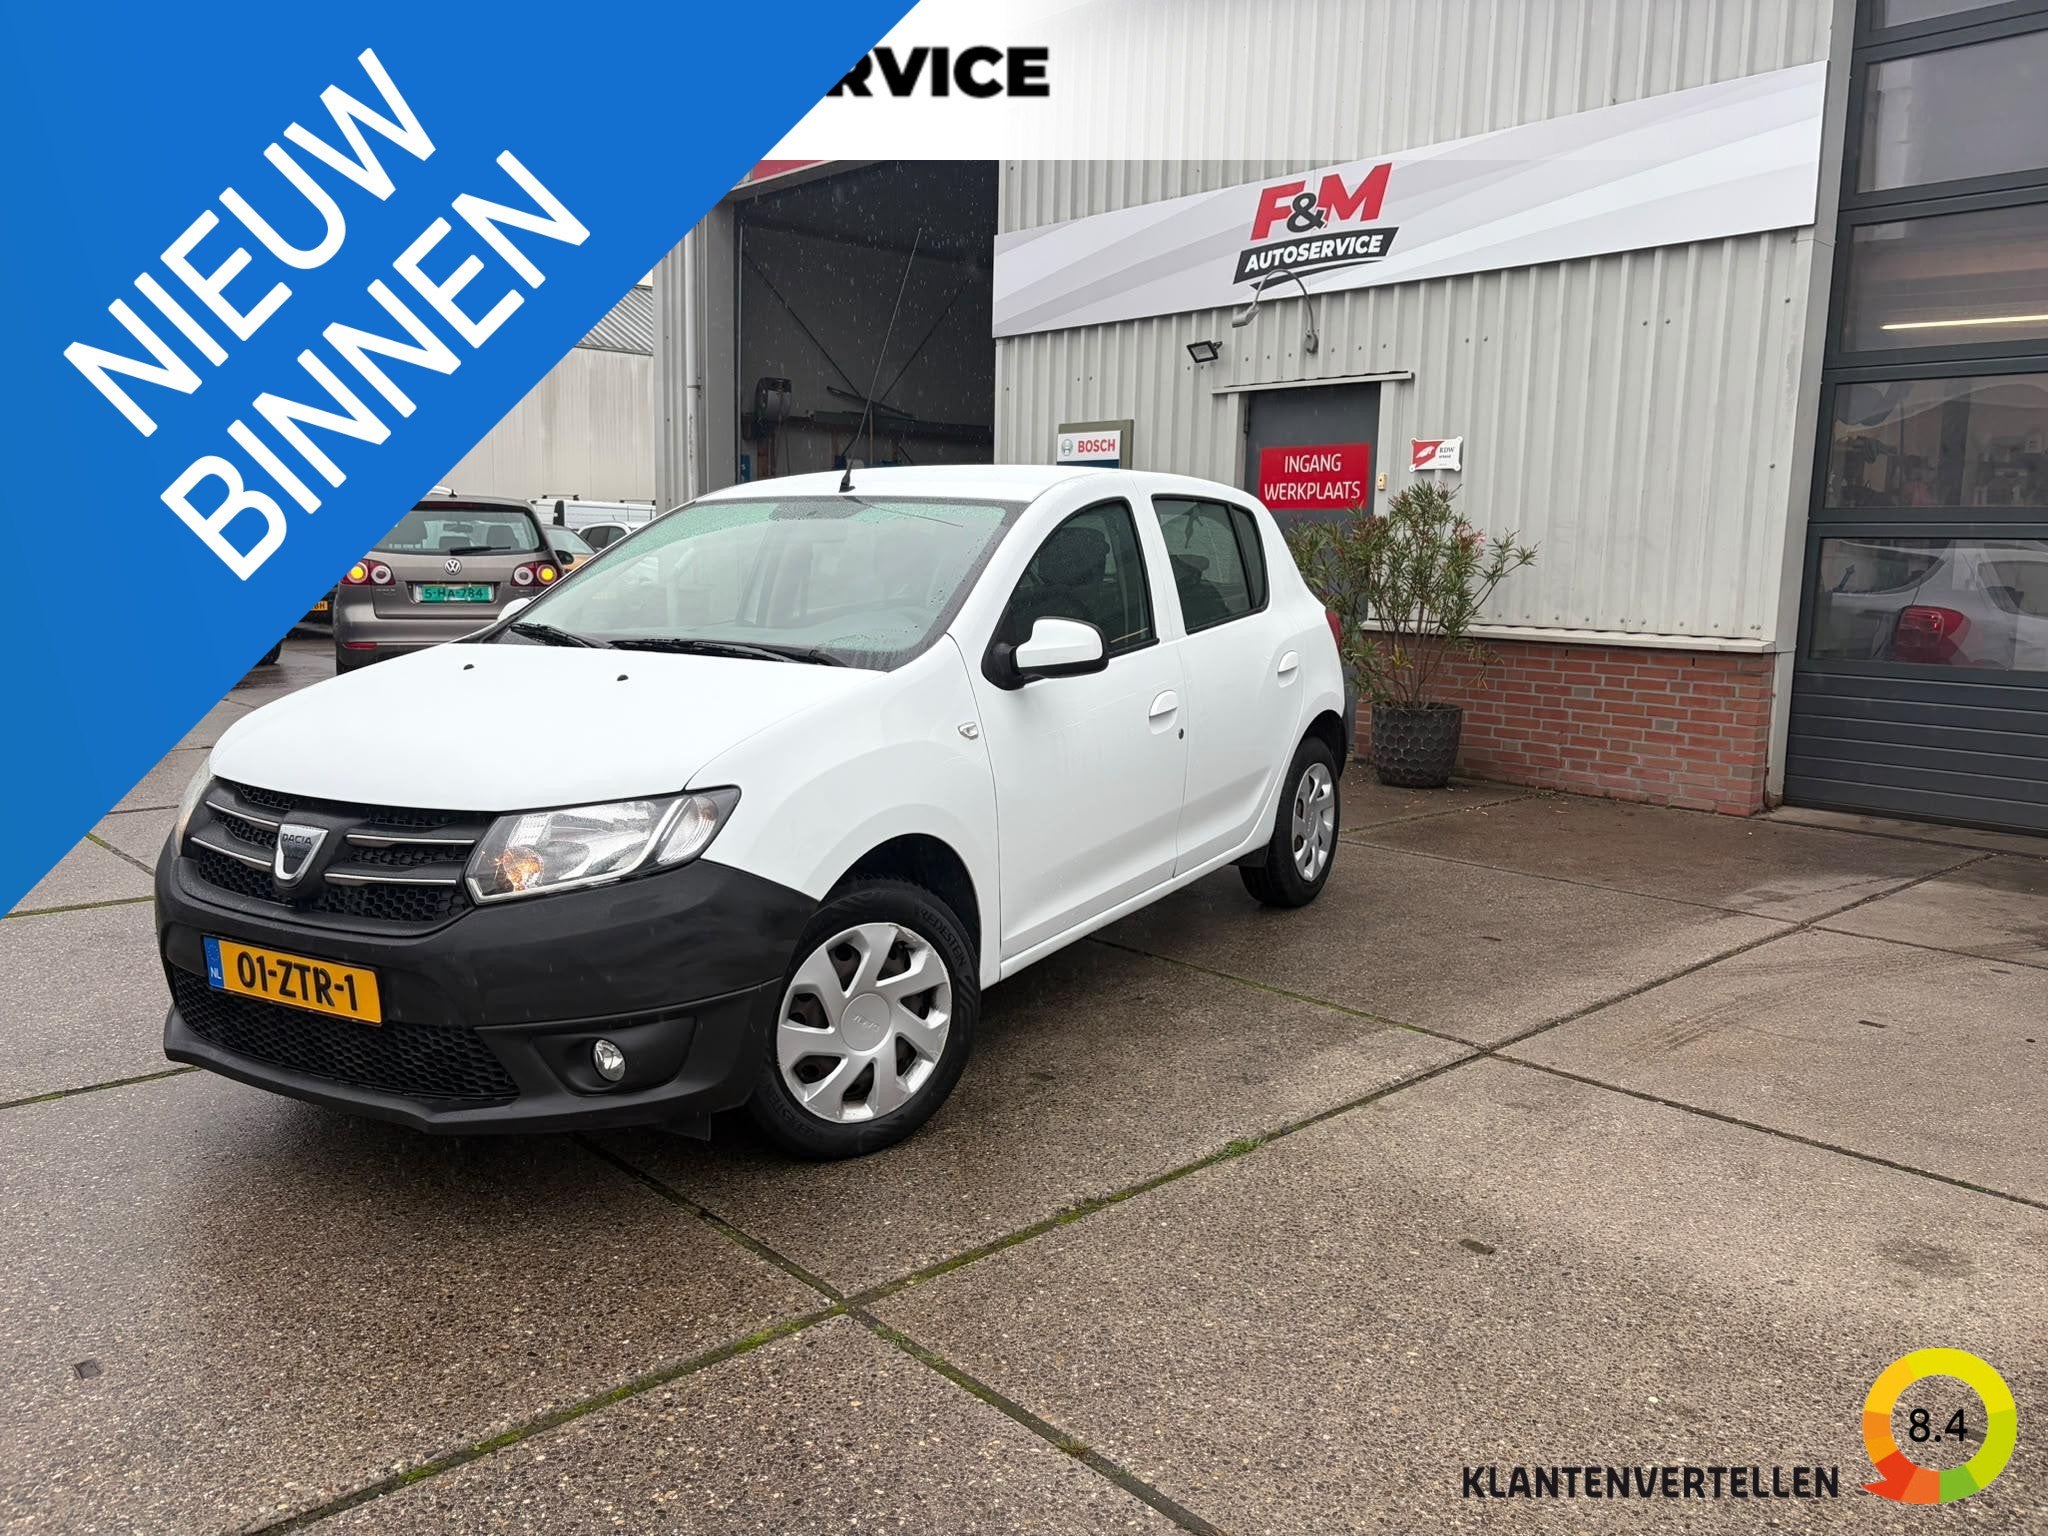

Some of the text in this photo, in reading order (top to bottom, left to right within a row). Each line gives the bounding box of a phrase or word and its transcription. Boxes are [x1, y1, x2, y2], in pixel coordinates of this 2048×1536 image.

[1250, 163, 1392, 241] F&M
[1244, 234, 1384, 273] AUTOSERVICE
[1077, 439, 1116, 453] BOSCH
[1284, 453, 1342, 473] INGANG
[1264, 481, 1361, 501] WERKPLAATS
[282, 833, 313, 846] DACIA
[210, 966, 222, 980] NL
[237, 951, 358, 1011] 01-ZTR-1
